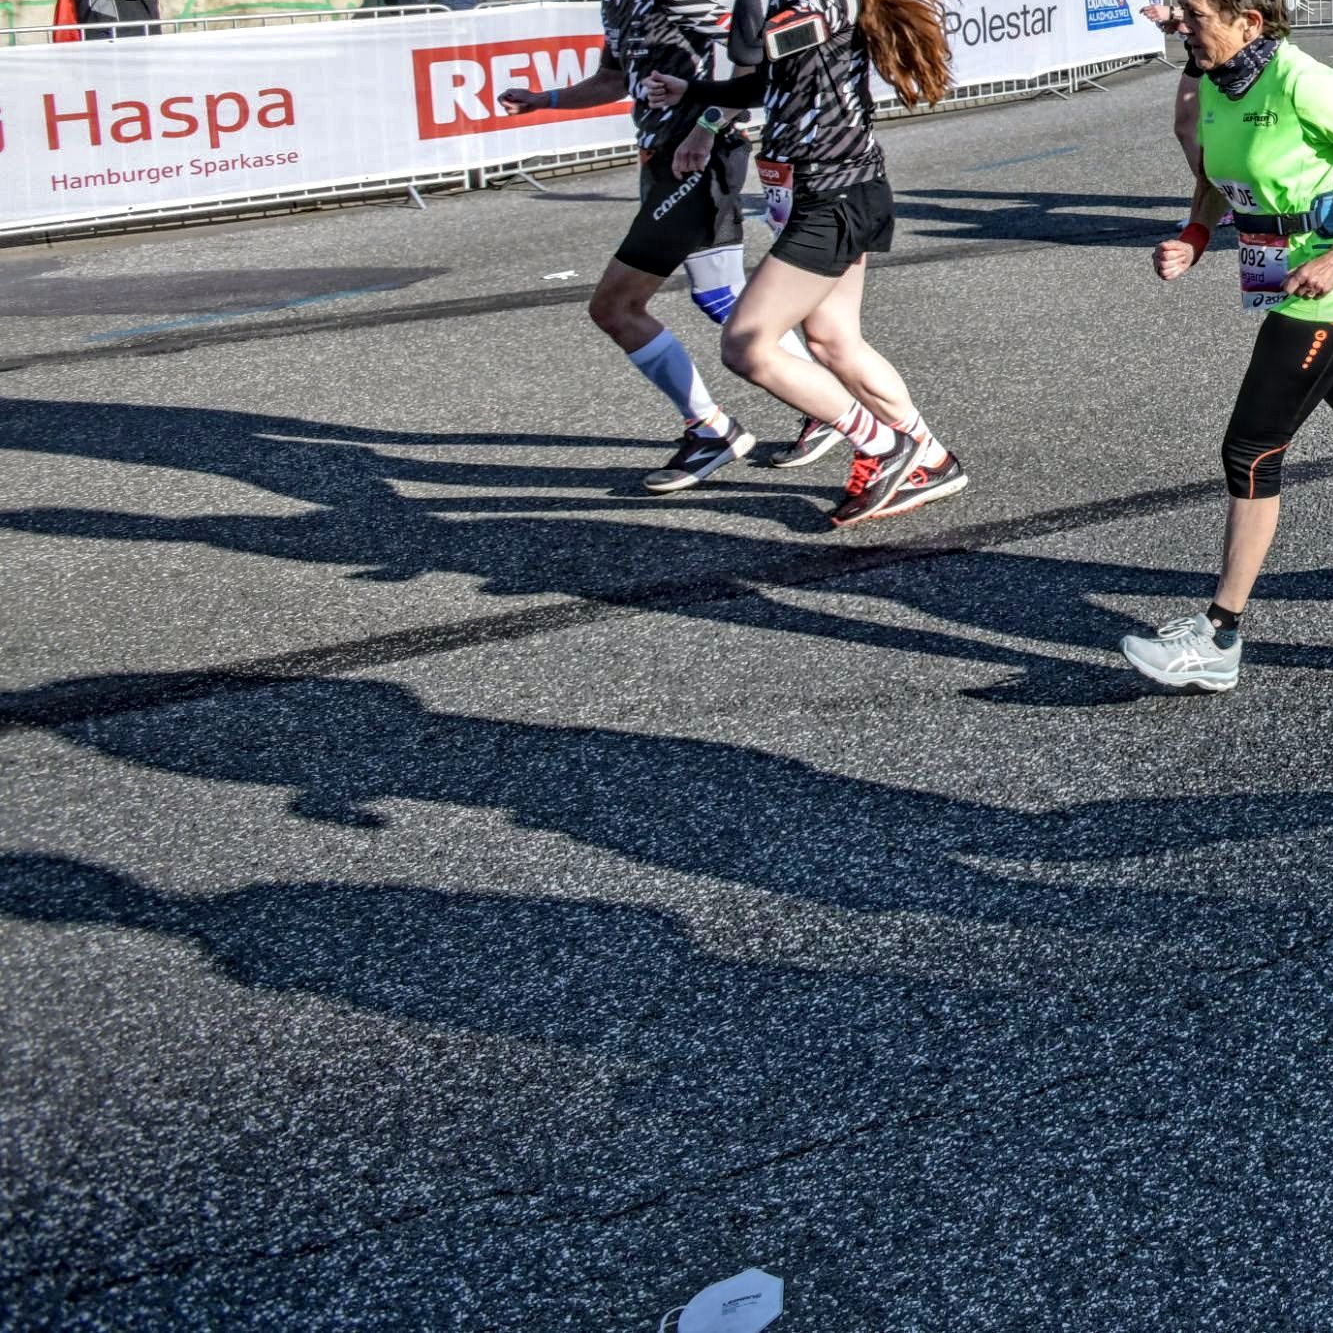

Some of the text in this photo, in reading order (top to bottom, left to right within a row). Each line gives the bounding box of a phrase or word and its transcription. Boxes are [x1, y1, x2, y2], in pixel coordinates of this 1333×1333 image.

[945, 4, 1057, 46] Polestar
[1088, 8, 1130, 22] ALKOHOLFREI
[429, 47, 601, 125] REW
[43, 87, 296, 150] Haspa
[51, 150, 299, 192] Hamburger Sparkasse
[1240, 247, 1283, 268] 092 Z
